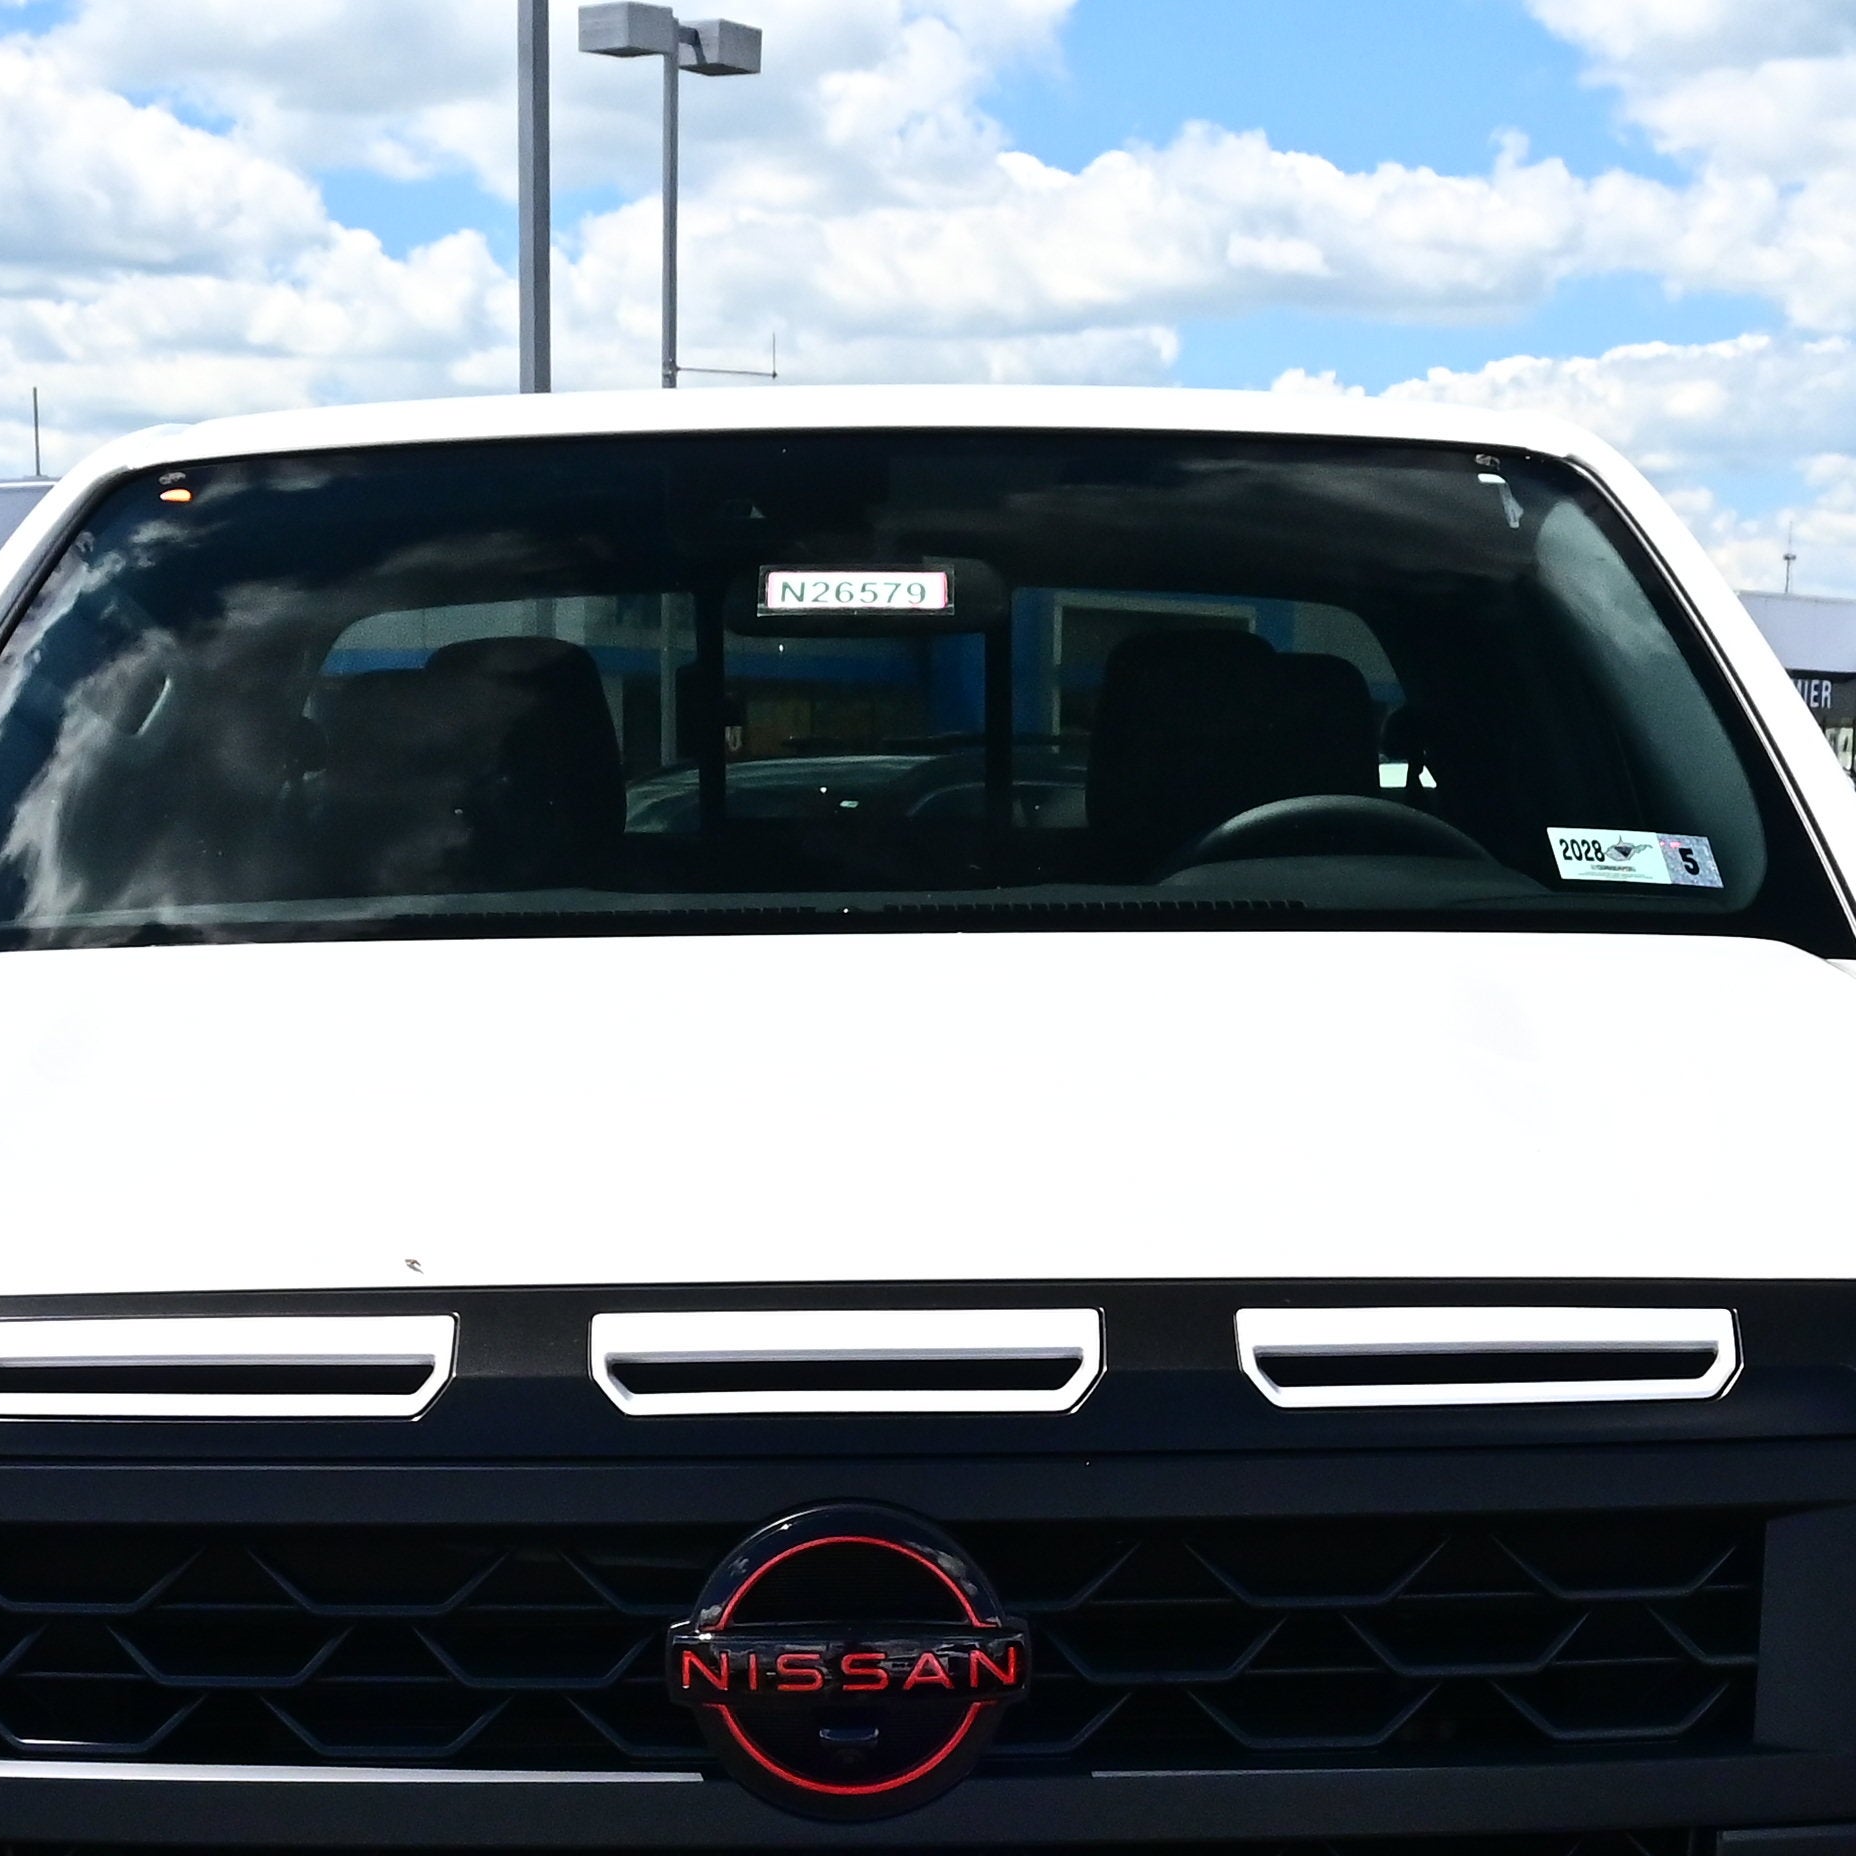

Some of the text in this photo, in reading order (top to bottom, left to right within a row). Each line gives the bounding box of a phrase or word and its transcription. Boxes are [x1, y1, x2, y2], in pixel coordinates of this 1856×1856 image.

[781, 581, 927, 605] N26579
[1559, 838, 1700, 876] 2028 5
[680, 1646, 1019, 1691] NISSAN
